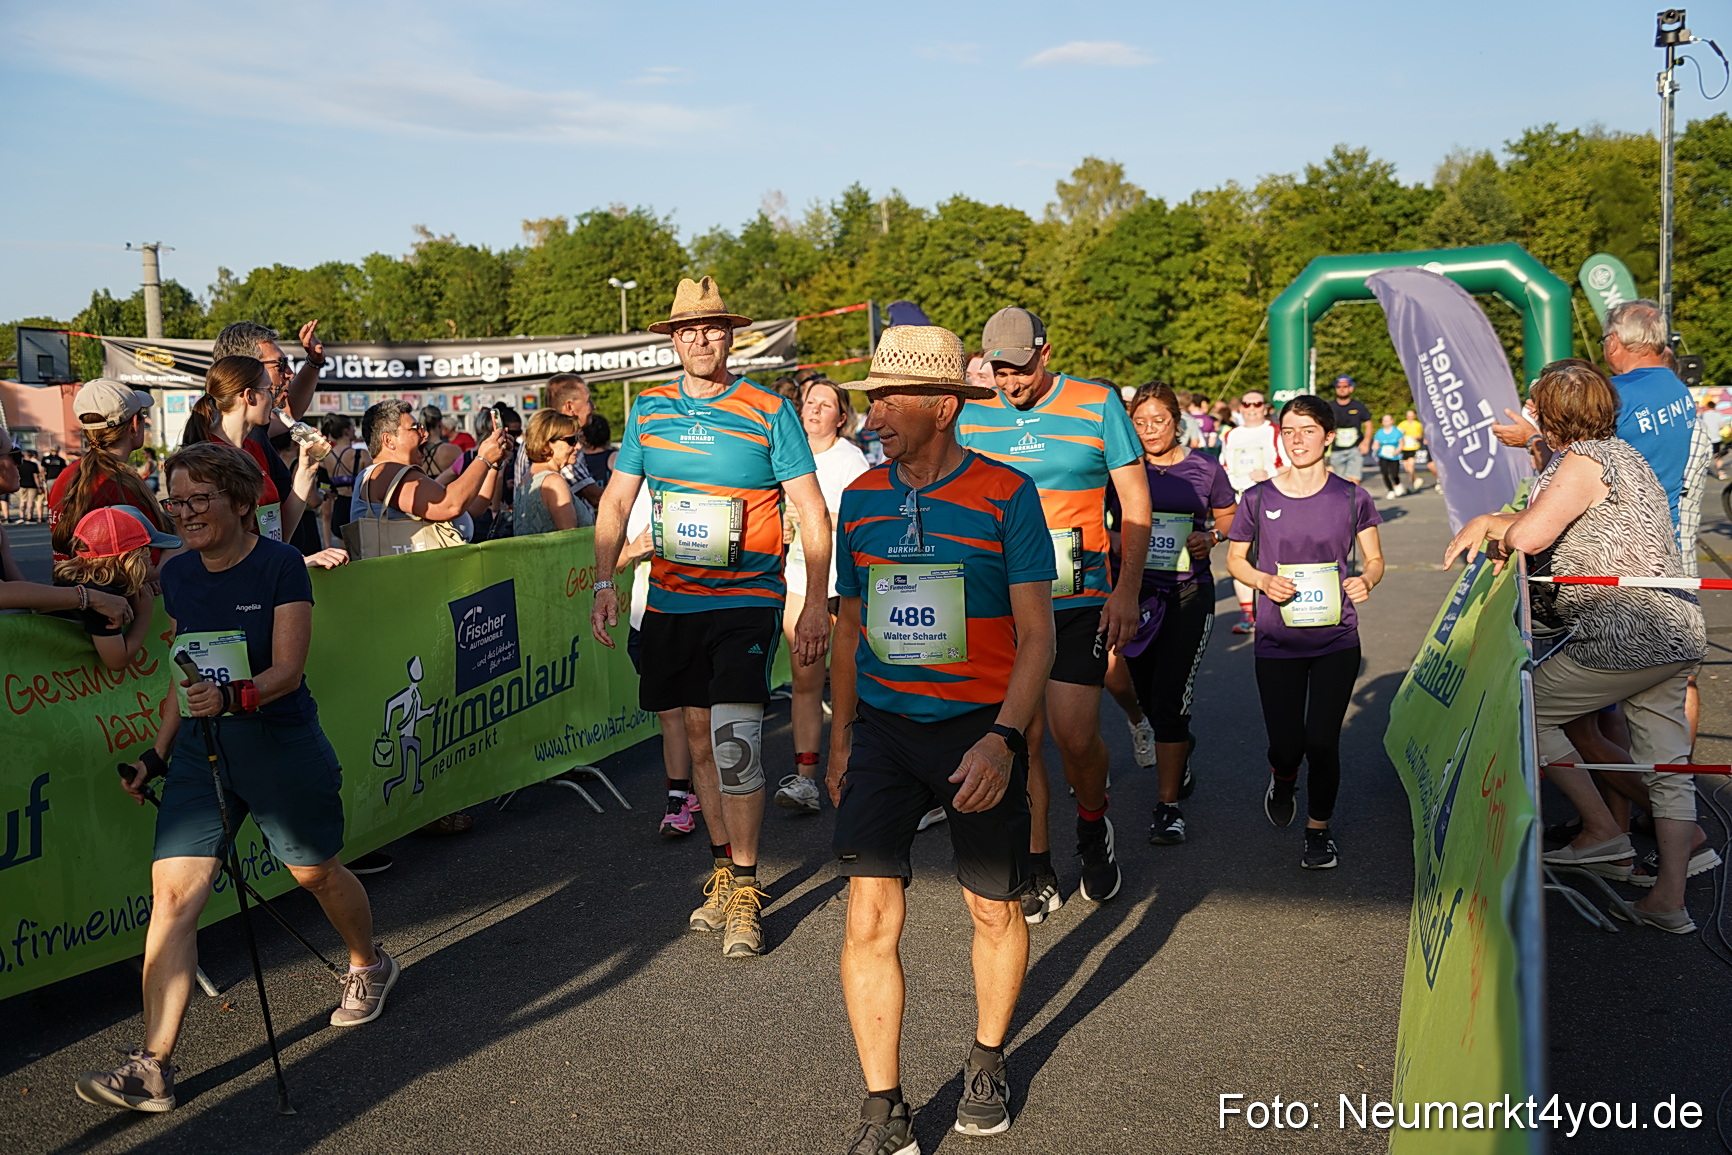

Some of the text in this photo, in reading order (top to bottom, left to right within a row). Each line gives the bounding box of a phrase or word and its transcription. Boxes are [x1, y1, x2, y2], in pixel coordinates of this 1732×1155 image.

[318, 354, 413, 378] Plätze.
[418, 351, 508, 382] Fertig.
[1635, 407, 1650, 419] bei
[677, 522, 709, 539] 485
[392, 542, 427, 555] THE
[691, 541, 709, 549] Meier
[236, 604, 261, 612] Angelika
[889, 607, 936, 627] 486
[466, 613, 507, 643] Fischer
[883, 632, 948, 641] Walter Schardt
[469, 629, 504, 651] AUTOMOBILE
[431, 635, 580, 762] firmenlauf
[432, 727, 499, 780] neumarkt
